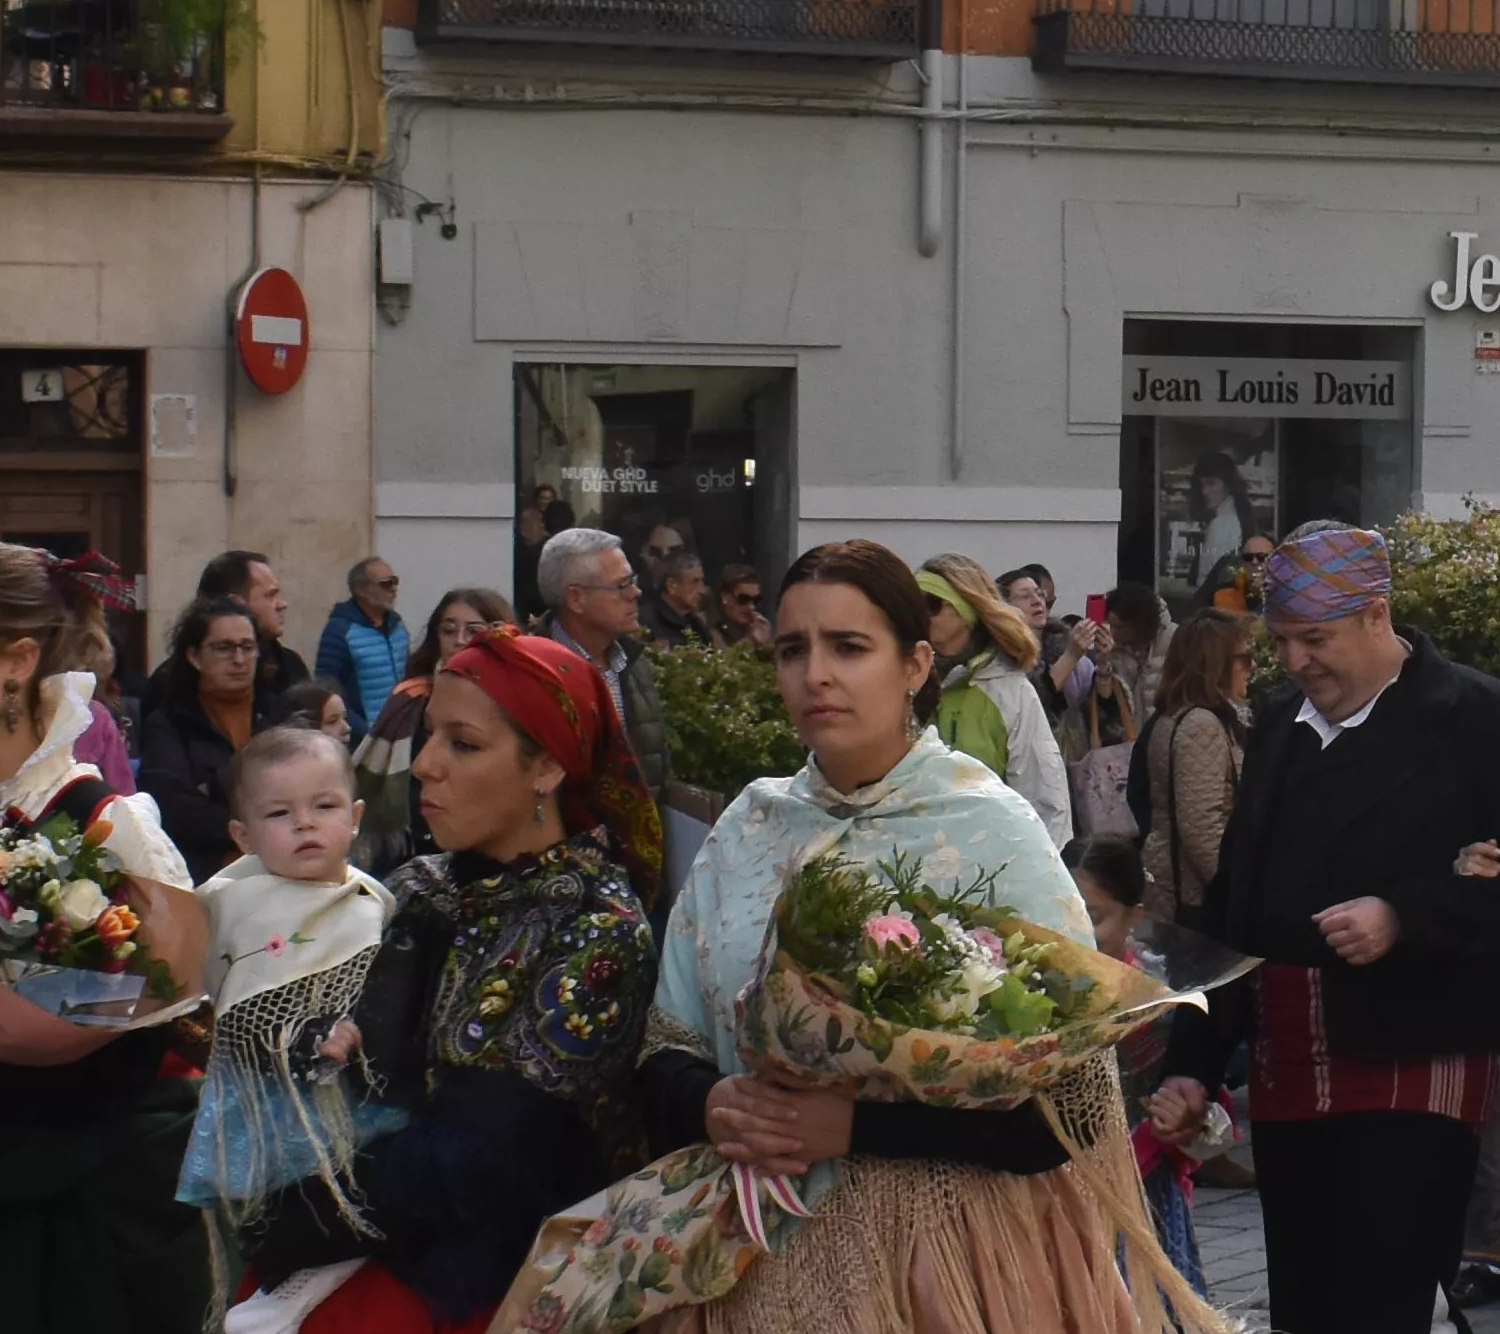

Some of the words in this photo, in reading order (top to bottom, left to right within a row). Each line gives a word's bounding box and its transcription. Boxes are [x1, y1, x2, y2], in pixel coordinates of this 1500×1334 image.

[35, 373, 52, 396] 4
[1133, 368, 1202, 402] Jean
[1217, 369, 1299, 404] Louis
[1314, 371, 1396, 406] David
[561, 467, 608, 480] NUEVA
[613, 468, 647, 480] GHD
[696, 468, 736, 493] ghd
[581, 480, 616, 493] DUET
[620, 480, 659, 493] STYLE
